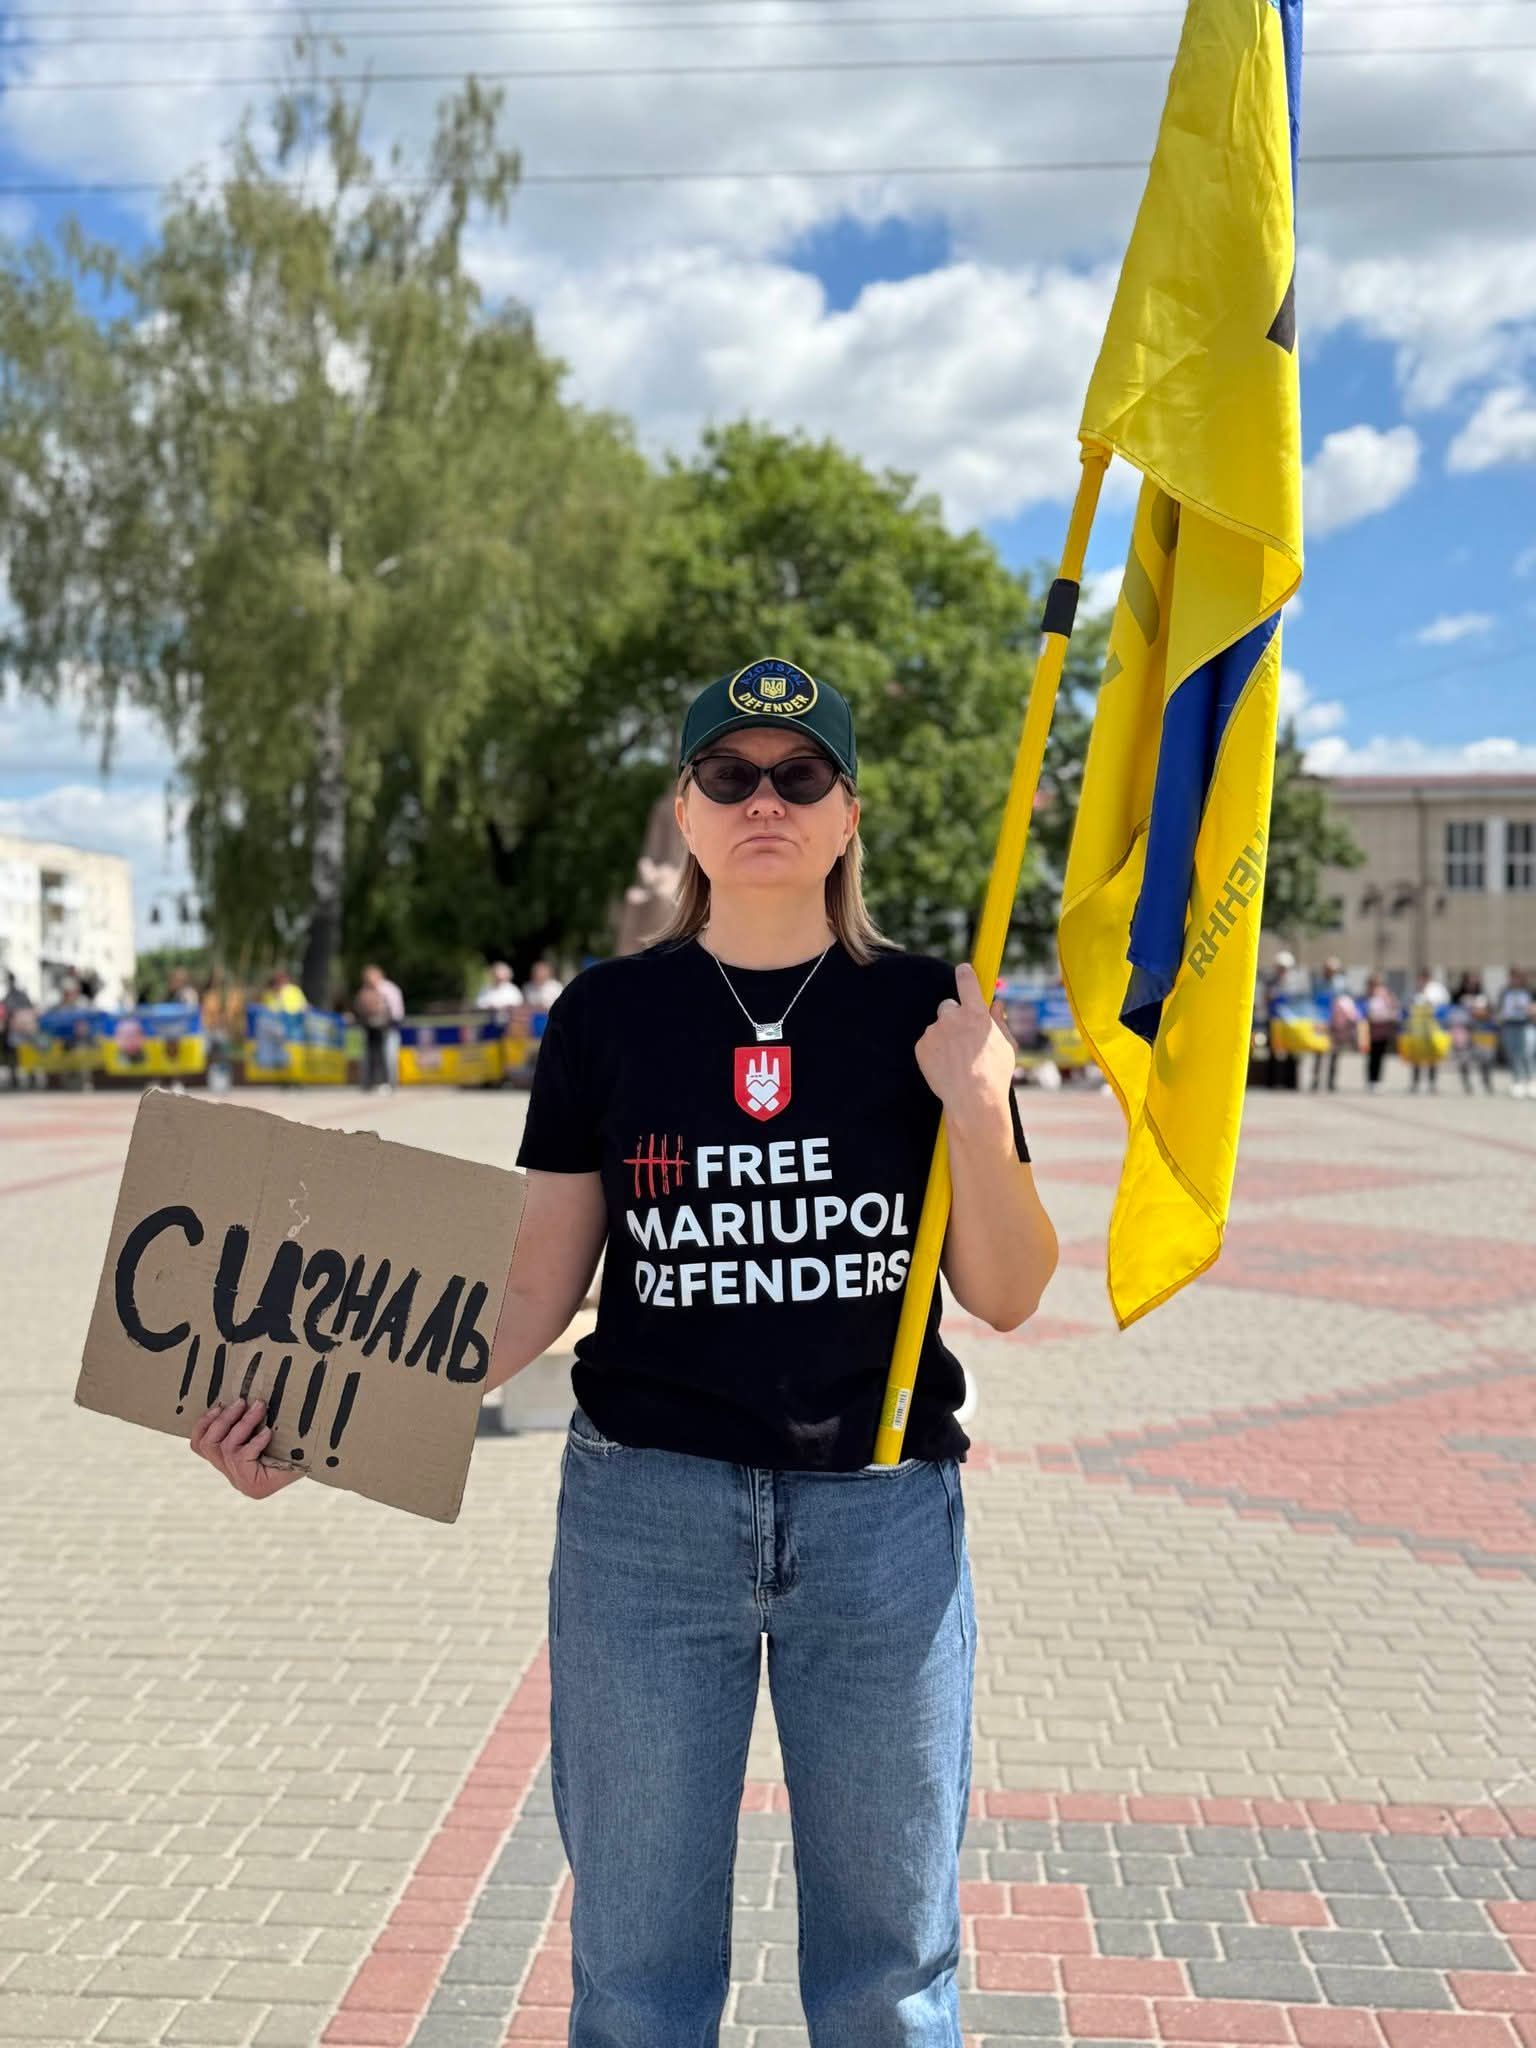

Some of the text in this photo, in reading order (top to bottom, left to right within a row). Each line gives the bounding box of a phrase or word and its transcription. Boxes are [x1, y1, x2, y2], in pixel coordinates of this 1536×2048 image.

[738, 692, 809, 712] DEFENDER
[697, 1137, 833, 1189] FREE
[626, 1192, 909, 1251] MARIUPOL
[635, 1249, 911, 1307] DEFENDERS
